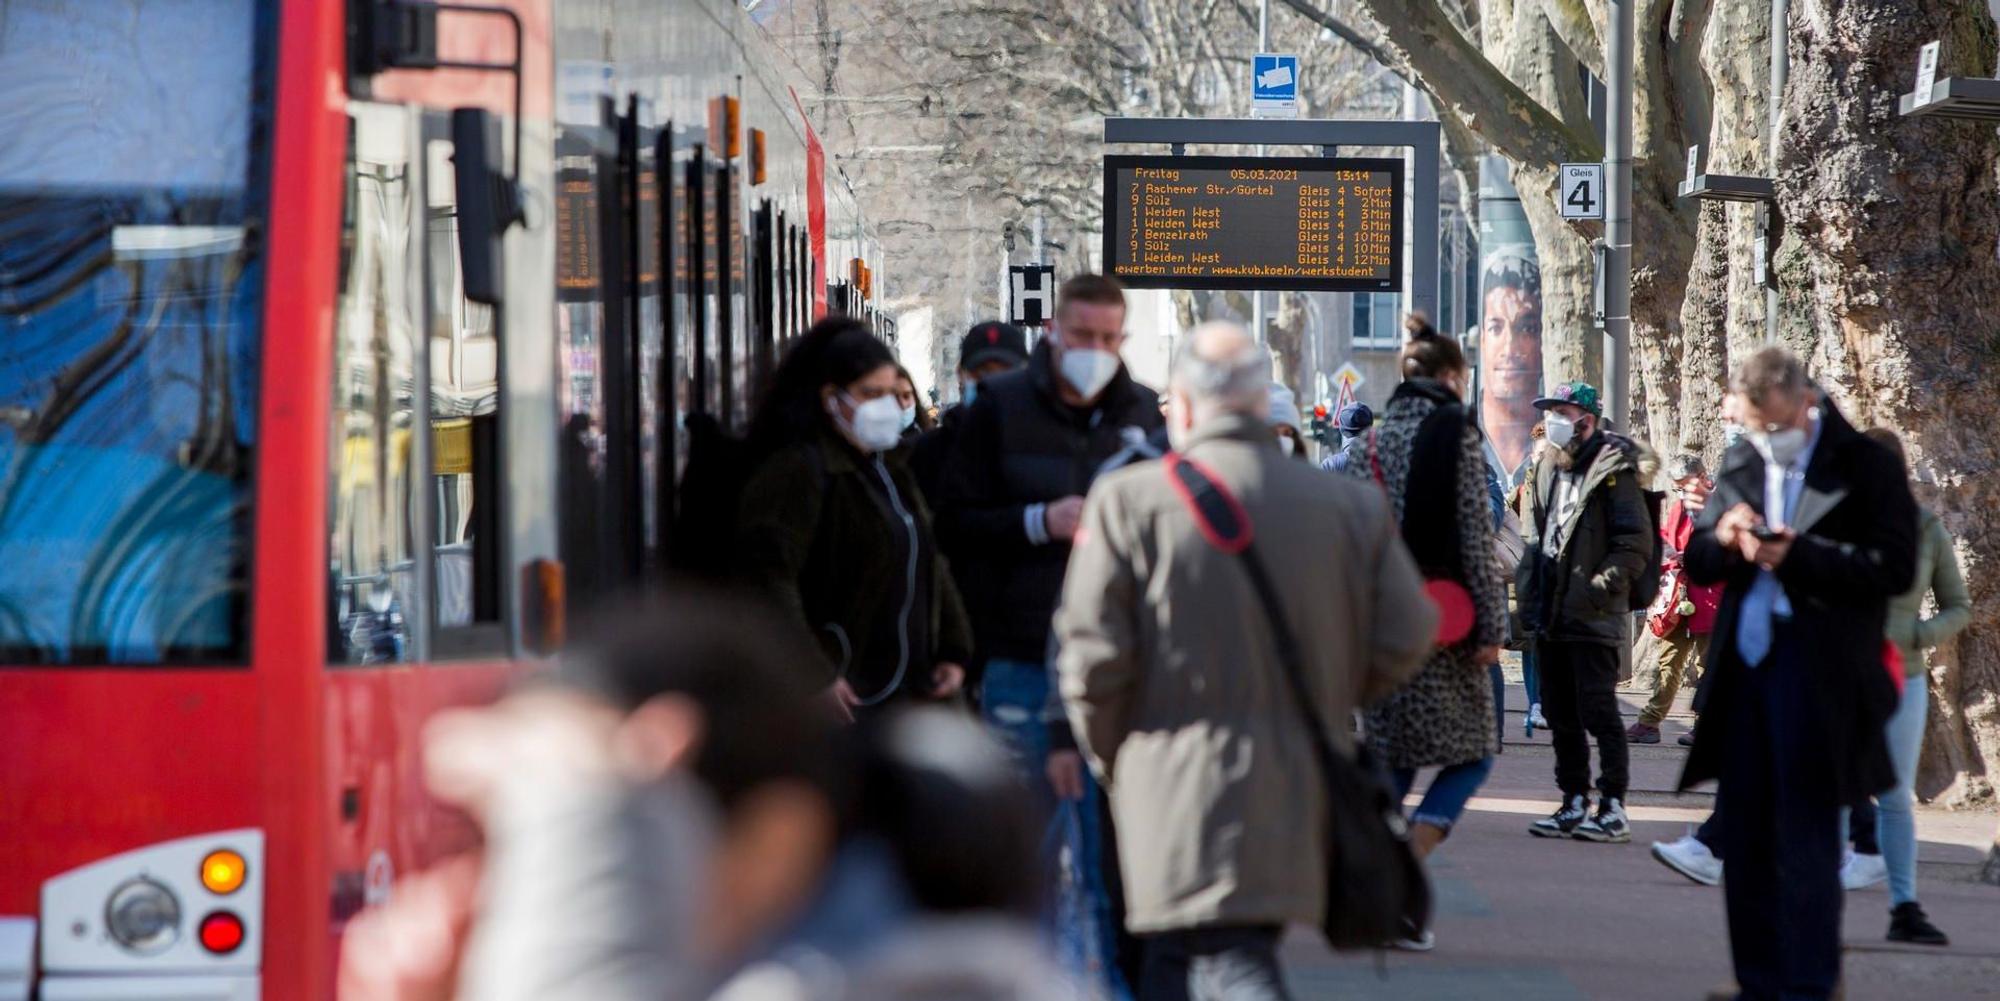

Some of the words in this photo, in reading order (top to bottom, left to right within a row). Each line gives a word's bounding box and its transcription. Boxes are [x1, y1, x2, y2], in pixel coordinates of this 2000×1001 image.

[1135, 168, 1180, 181] Freitag
[1230, 169, 1298, 180] 05.03.2021
[1336, 171, 1369, 181] 13:14
[1570, 168, 1593, 177] Gleis
[1132, 183, 1139, 193] 7
[1145, 183, 1198, 194] Aachener
[1300, 186, 1330, 196] Gleis
[1338, 186, 1345, 195] 4
[1354, 186, 1392, 197] Sofort
[1132, 195, 1139, 205] 9
[1299, 197, 1330, 207] Gleis
[1338, 197, 1344, 207] 4
[1567, 180, 1596, 213] 4
[1133, 207, 1138, 216] 1
[1145, 207, 1185, 217] Weiden
[1193, 207, 1221, 217] West
[1299, 209, 1329, 218] Gleis
[1338, 209, 1344, 219] 4
[1132, 219, 1138, 228] 1
[1145, 219, 1185, 228] Weiden
[1192, 219, 1220, 229] West
[1299, 220, 1329, 230] Gleis
[1337, 221, 1344, 230] 4
[1131, 229, 1138, 239] 7
[1145, 229, 1208, 240] Benzelrath
[1299, 232, 1329, 241] Gleis
[1337, 232, 1344, 241] 4
[1131, 241, 1138, 250] 9
[1298, 243, 1329, 253] Gleis
[1337, 243, 1344, 253] 4
[1132, 253, 1137, 262] 1
[1145, 253, 1184, 262] Weiden
[1192, 253, 1220, 262] West
[1298, 255, 1329, 264] Gleis
[1337, 255, 1344, 264] 4
[1173, 265, 1204, 274] unter
[1212, 264, 1374, 276] www.kvb.koeln/werkstudent
[1012, 272, 1052, 320] H
